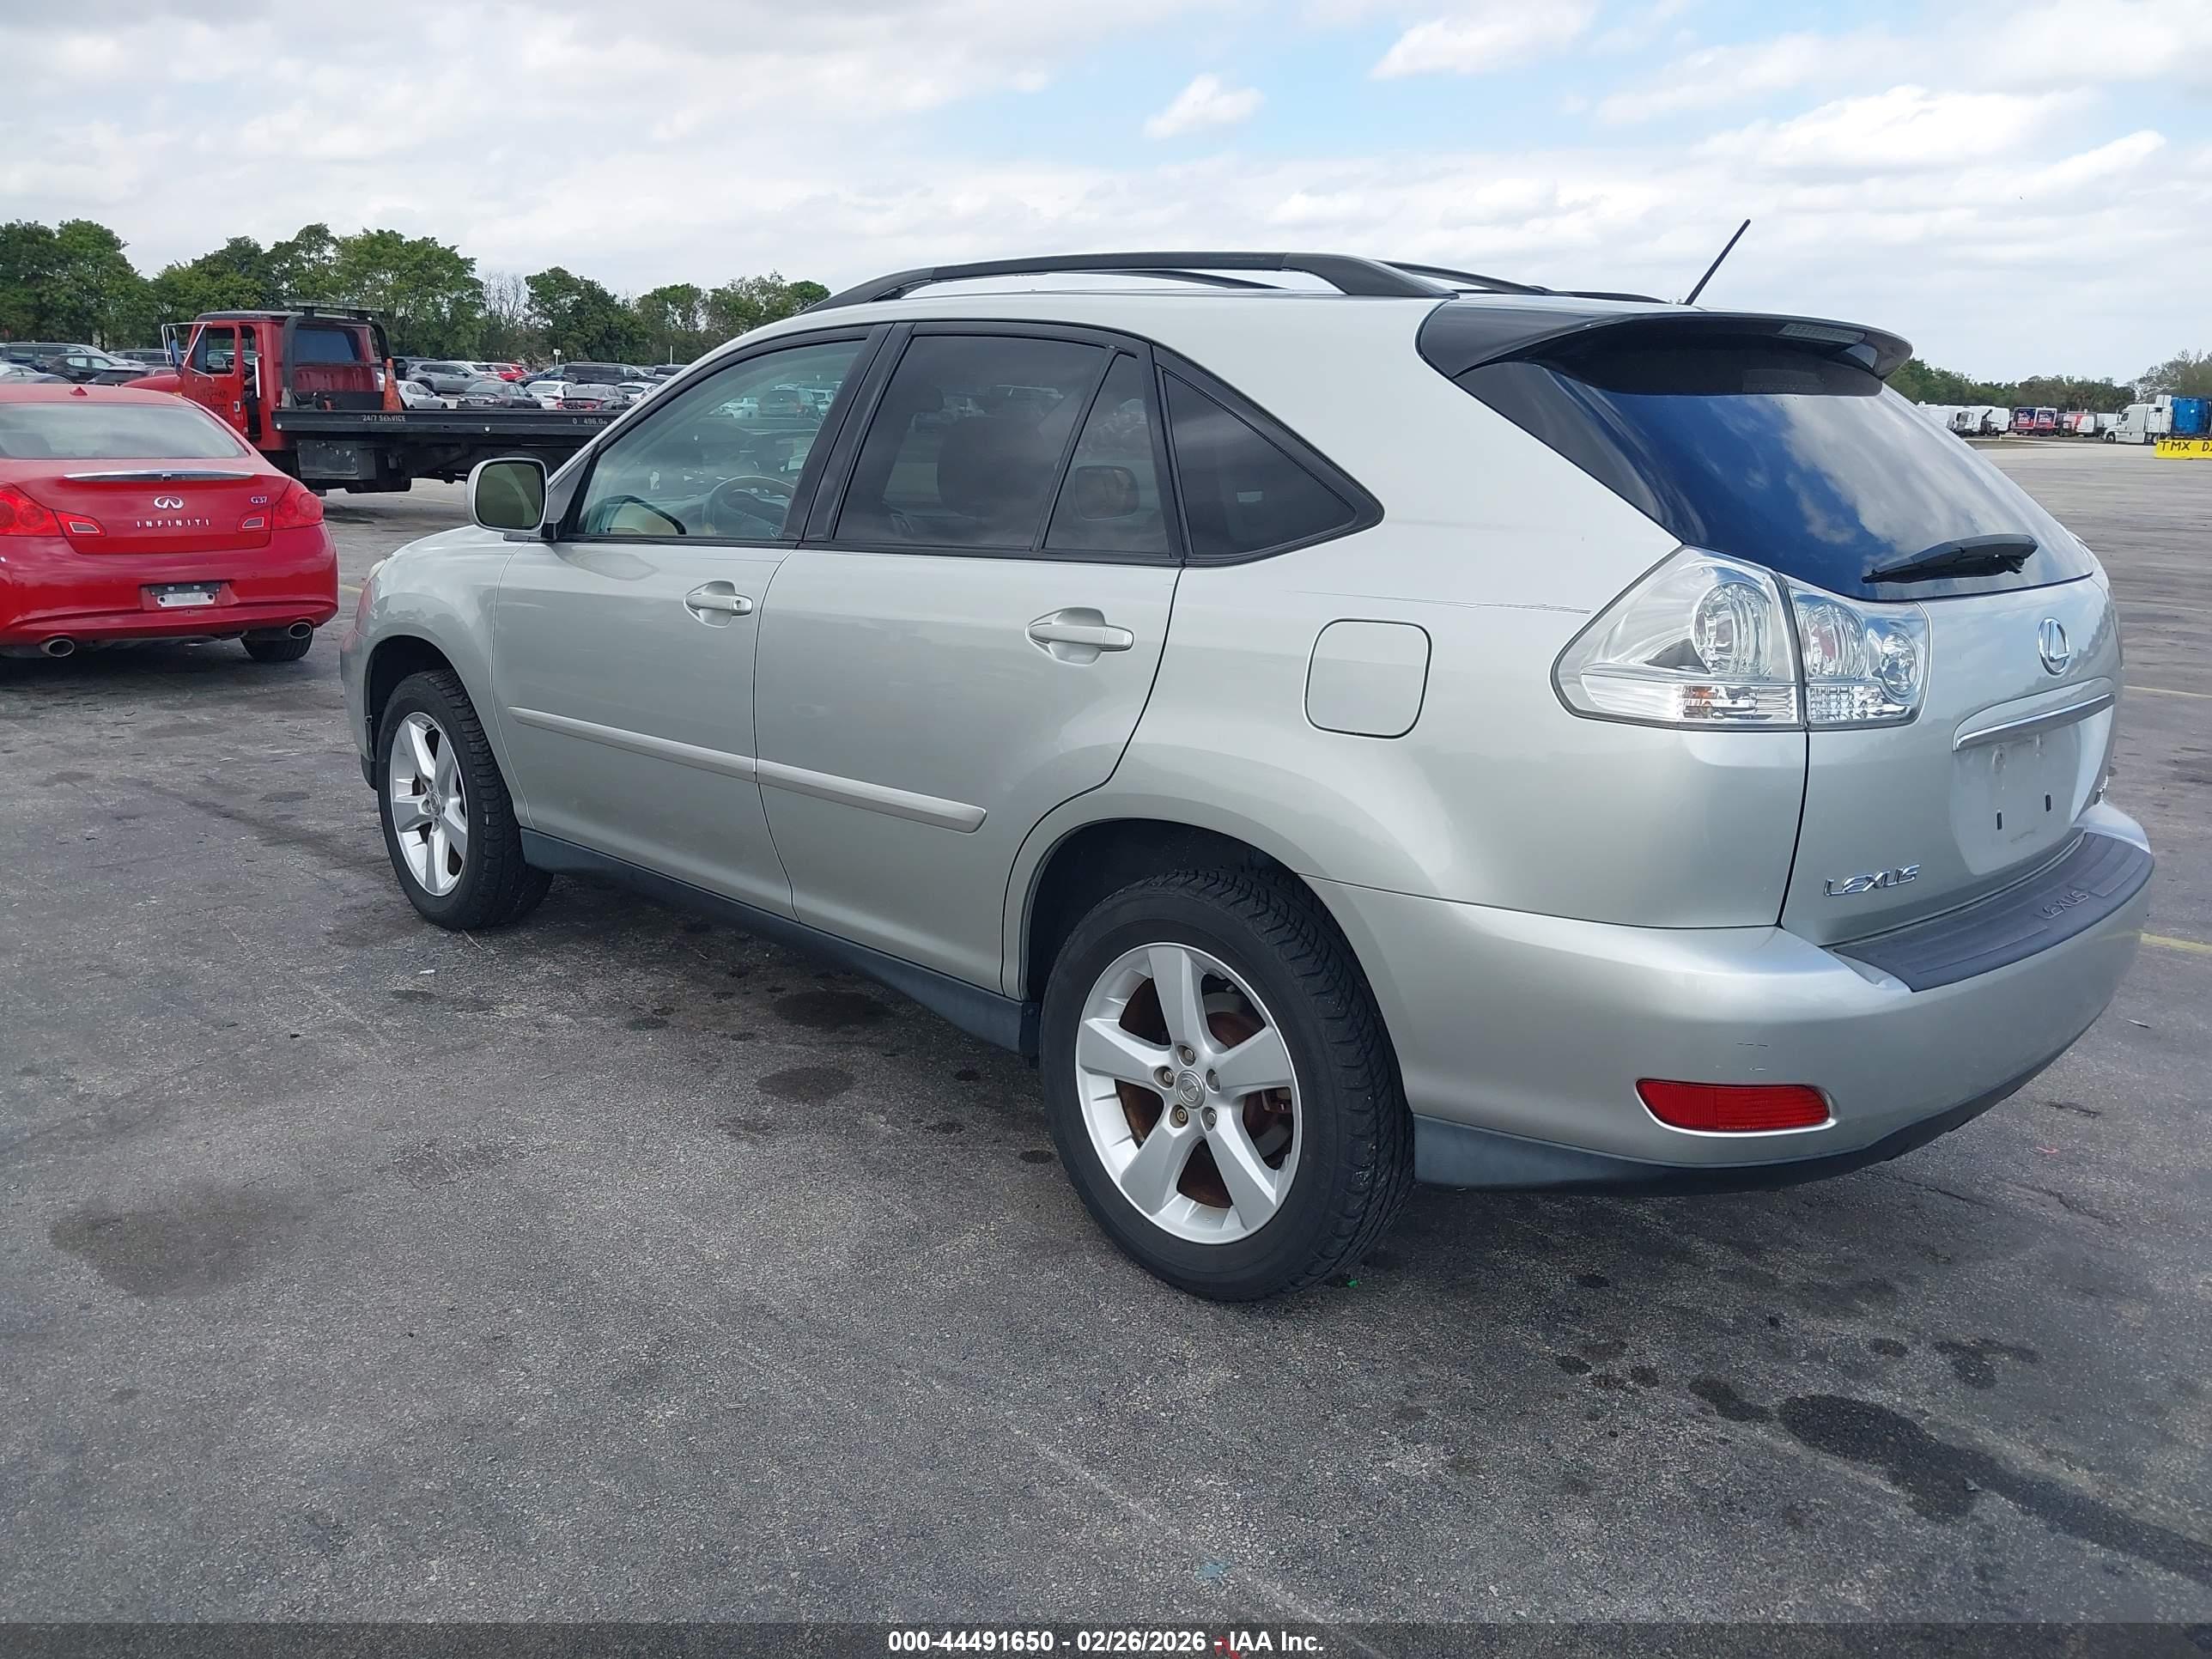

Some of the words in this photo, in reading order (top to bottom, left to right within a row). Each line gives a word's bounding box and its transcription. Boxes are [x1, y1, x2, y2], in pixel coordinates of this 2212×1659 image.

[2160, 441, 2191, 452] TMX
[251, 495, 268, 504] G37
[137, 519, 210, 528] INFINITI
[1823, 864, 1920, 896] LEXUS
[2033, 888, 2089, 921] LEXUS
